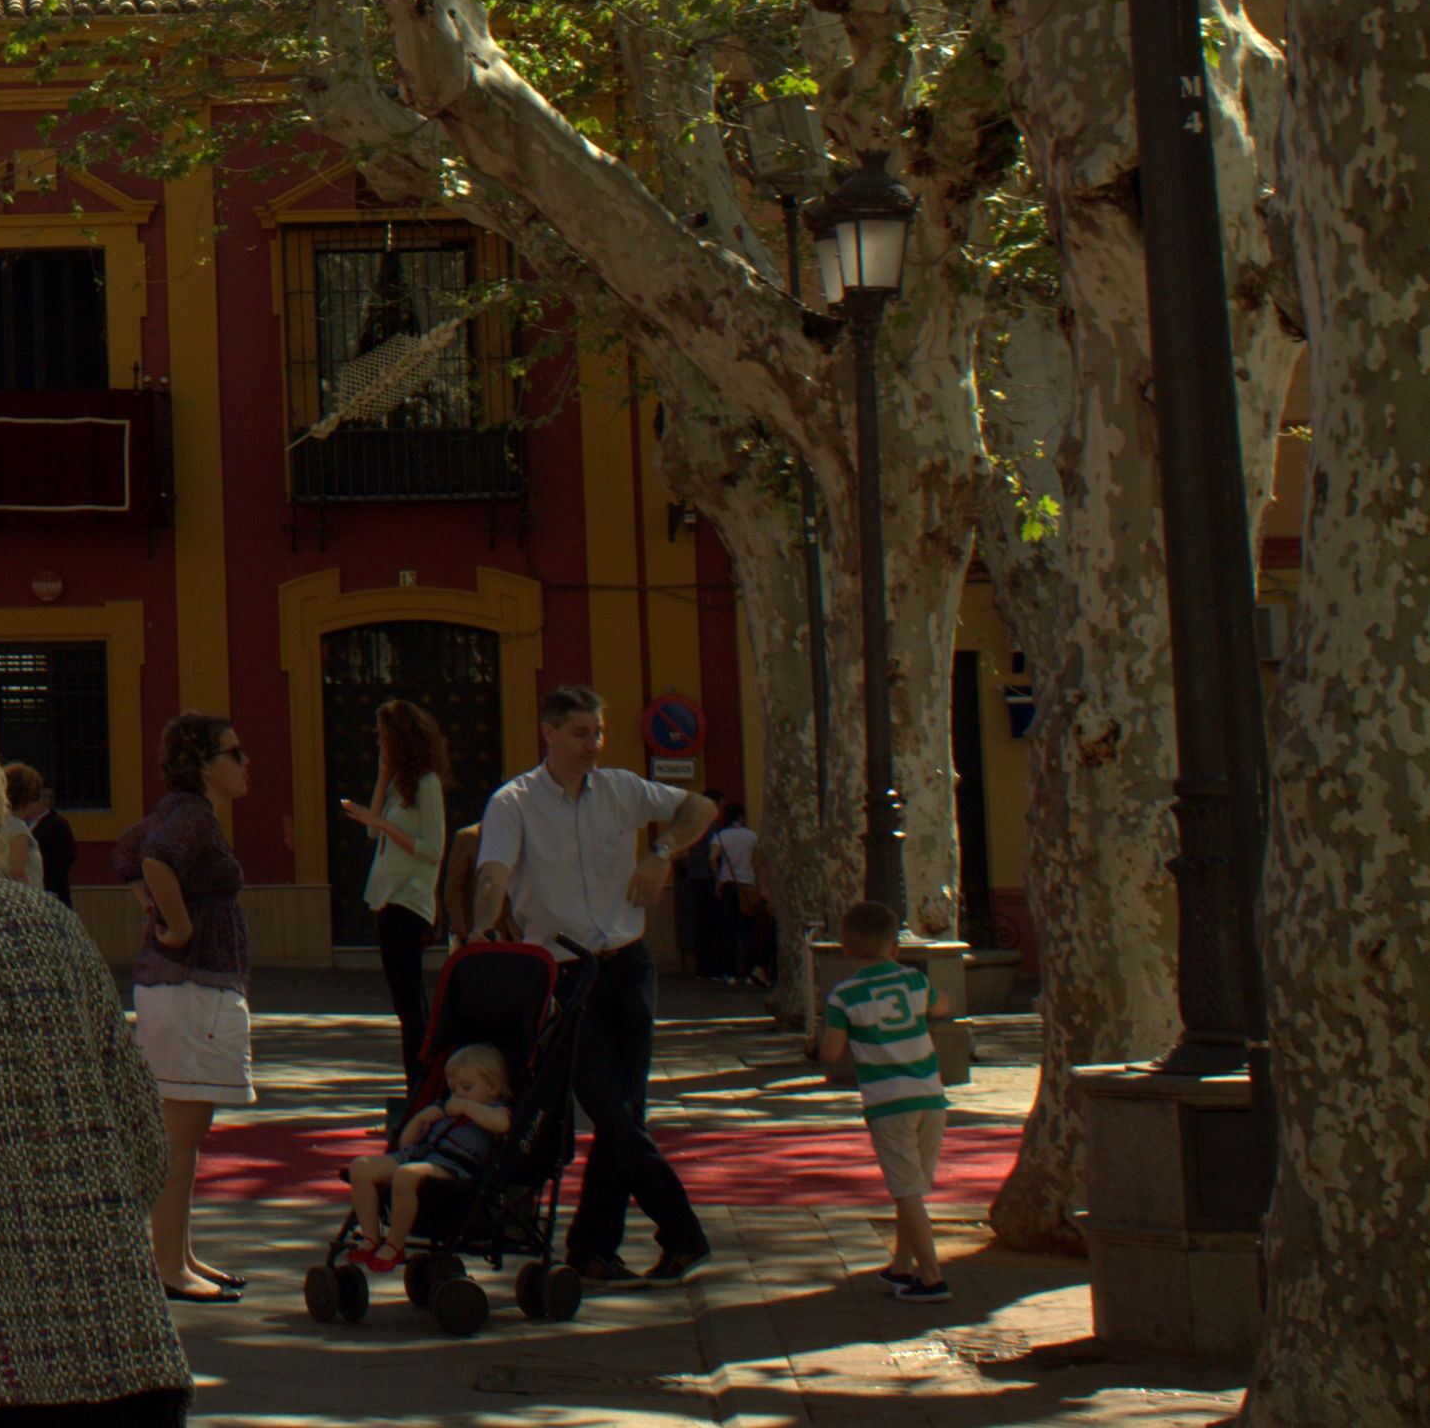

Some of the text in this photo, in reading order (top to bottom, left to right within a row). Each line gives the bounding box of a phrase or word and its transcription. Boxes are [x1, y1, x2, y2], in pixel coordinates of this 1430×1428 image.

[1179, 75, 1203, 99] M
[1182, 110, 1204, 133] 4
[875, 988, 911, 1025] 3
